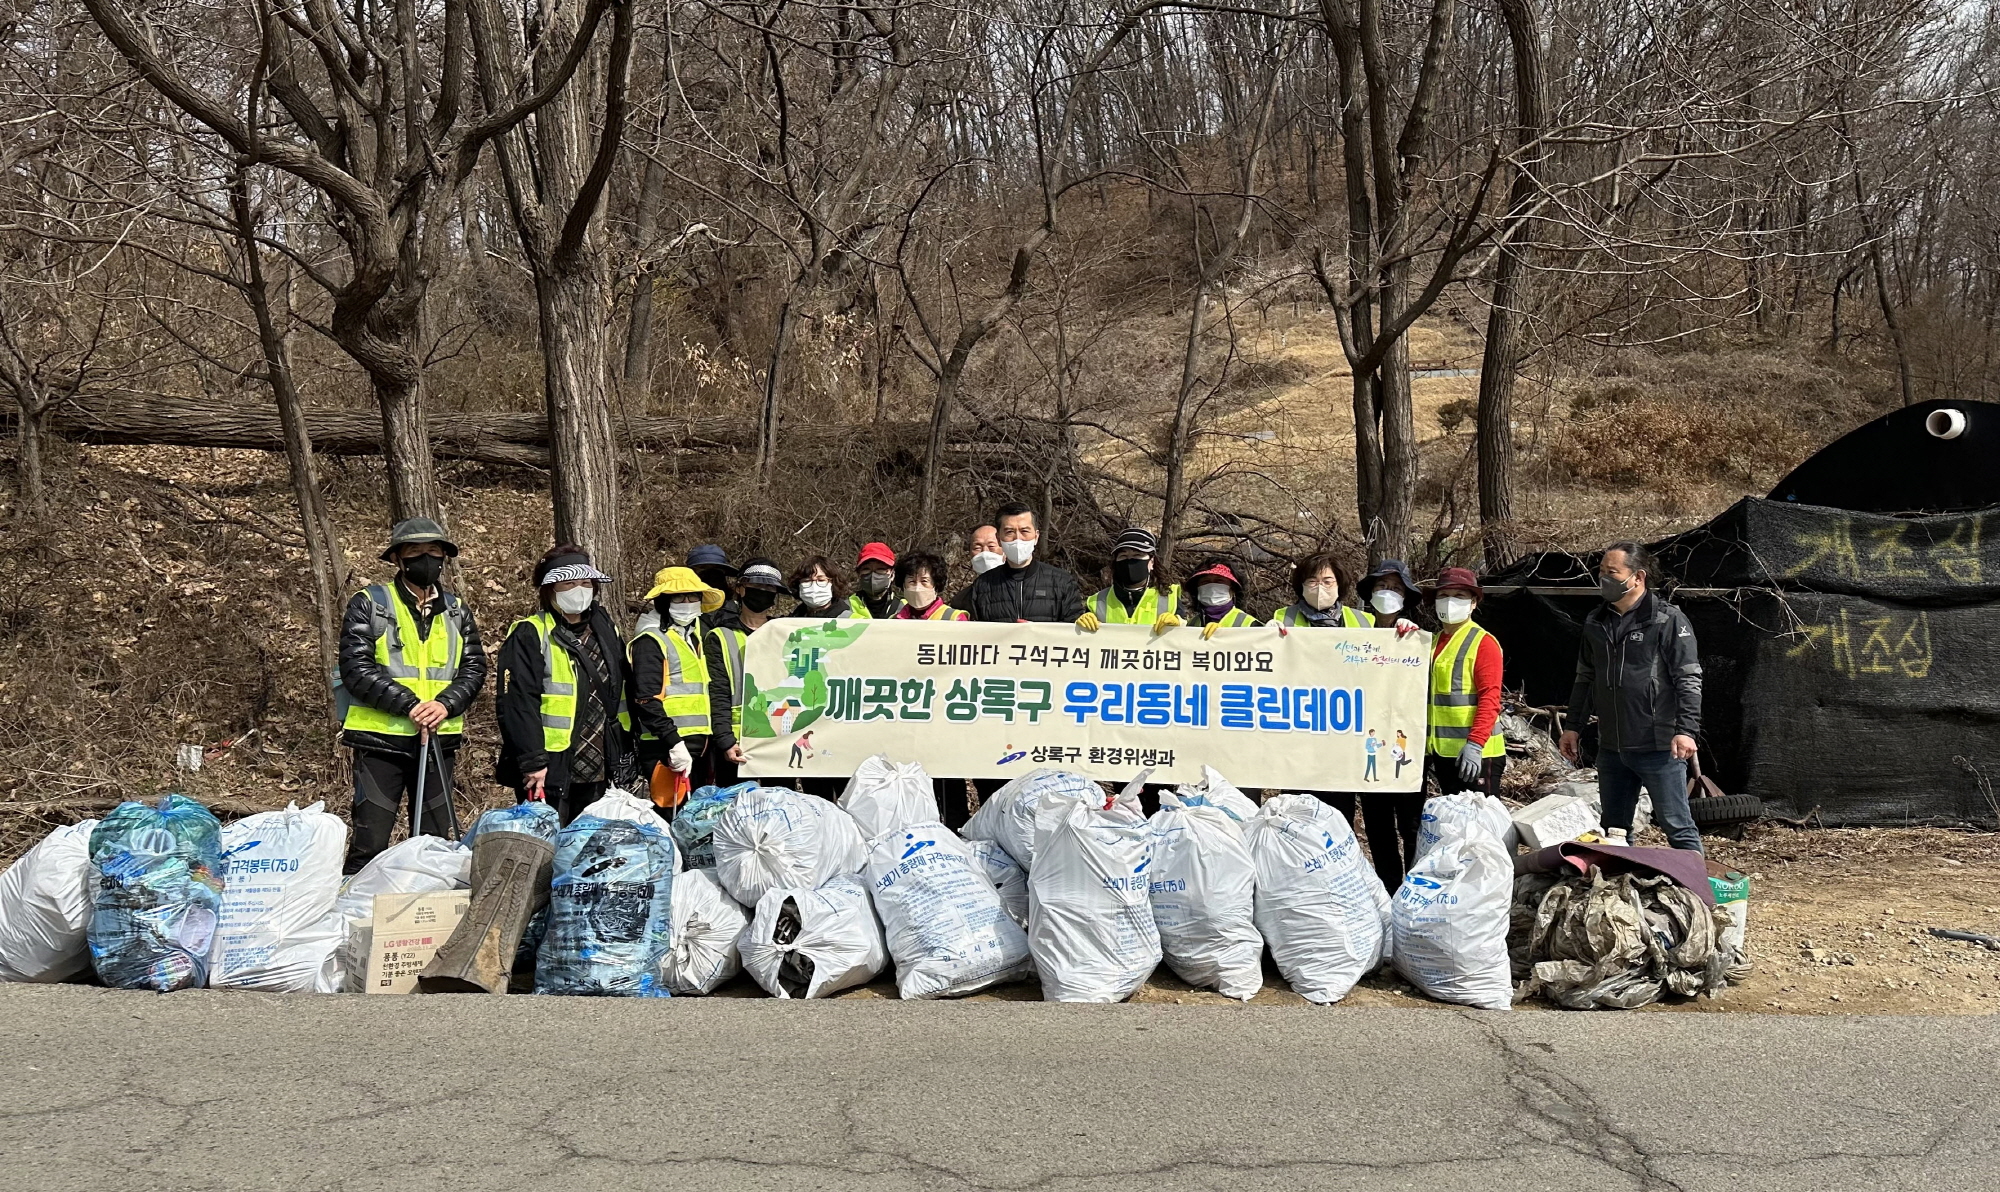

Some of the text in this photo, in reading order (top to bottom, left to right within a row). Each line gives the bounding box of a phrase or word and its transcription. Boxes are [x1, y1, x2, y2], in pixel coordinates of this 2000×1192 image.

[917, 643, 1274, 673] 동네마다 구석구석 깨끗하면 복이와요
[1402, 656, 1422, 666] 안산
[826, 677, 1364, 734] 깨끗한 상록구 우리동네 클린데이
[1030, 745, 1175, 767] 상록구 환경위생과
[875, 868, 901, 894] 쓰레기
[898, 856, 927, 875] 종량제
[383, 938, 420, 948] LG 생활건강
